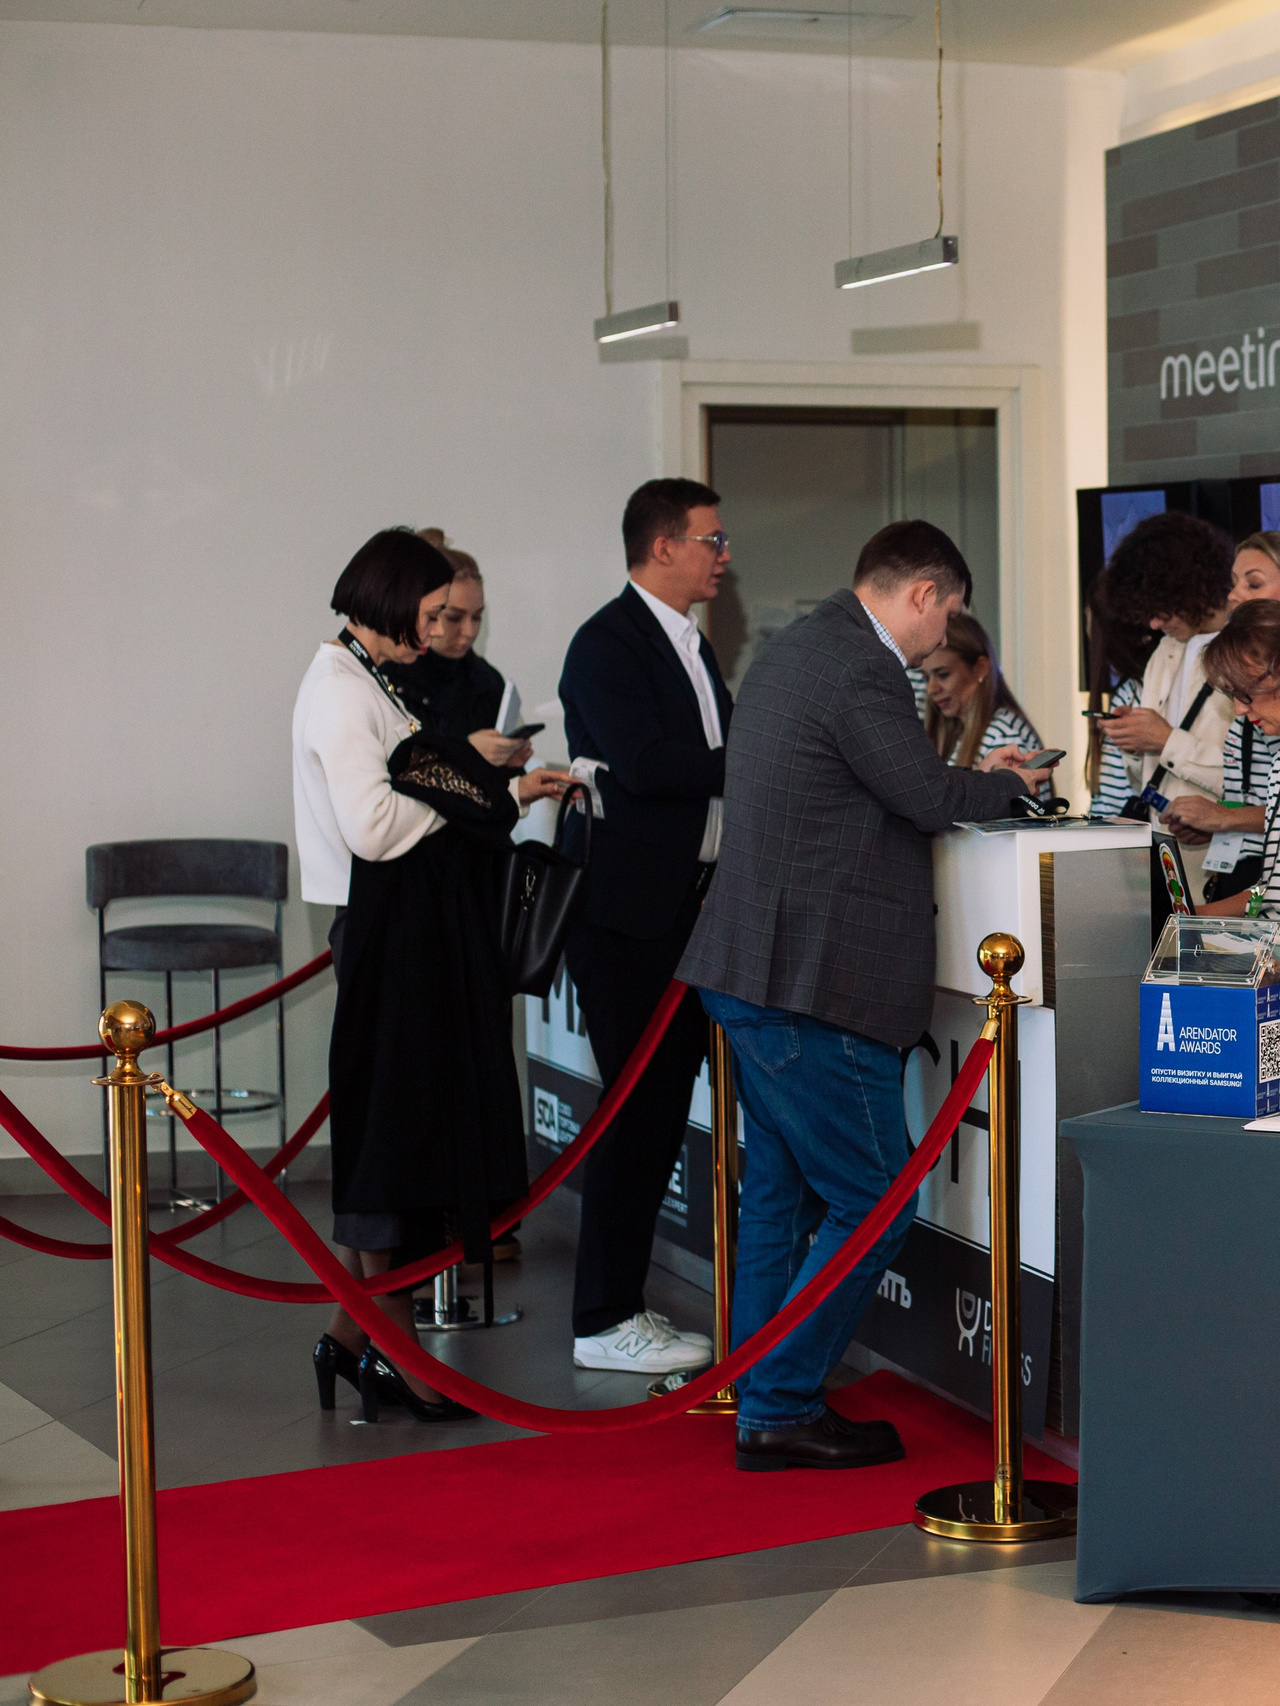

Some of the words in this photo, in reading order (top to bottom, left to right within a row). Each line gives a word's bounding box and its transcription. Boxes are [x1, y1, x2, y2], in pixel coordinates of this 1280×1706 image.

[1179, 1026, 1237, 1042] ARENDATOR
[1179, 1040, 1221, 1055] AWARDS
[1150, 1068, 1176, 1076] ОПУСТИ
[1177, 1069, 1205, 1078] ВИЗИТКУ
[1212, 1071, 1243, 1079] ВЫИГРАЙ
[1151, 1076, 1209, 1085] КОЛЛЕКЦИОННЫЙ
[1209, 1080, 1242, 1088] SAMSUNG!
